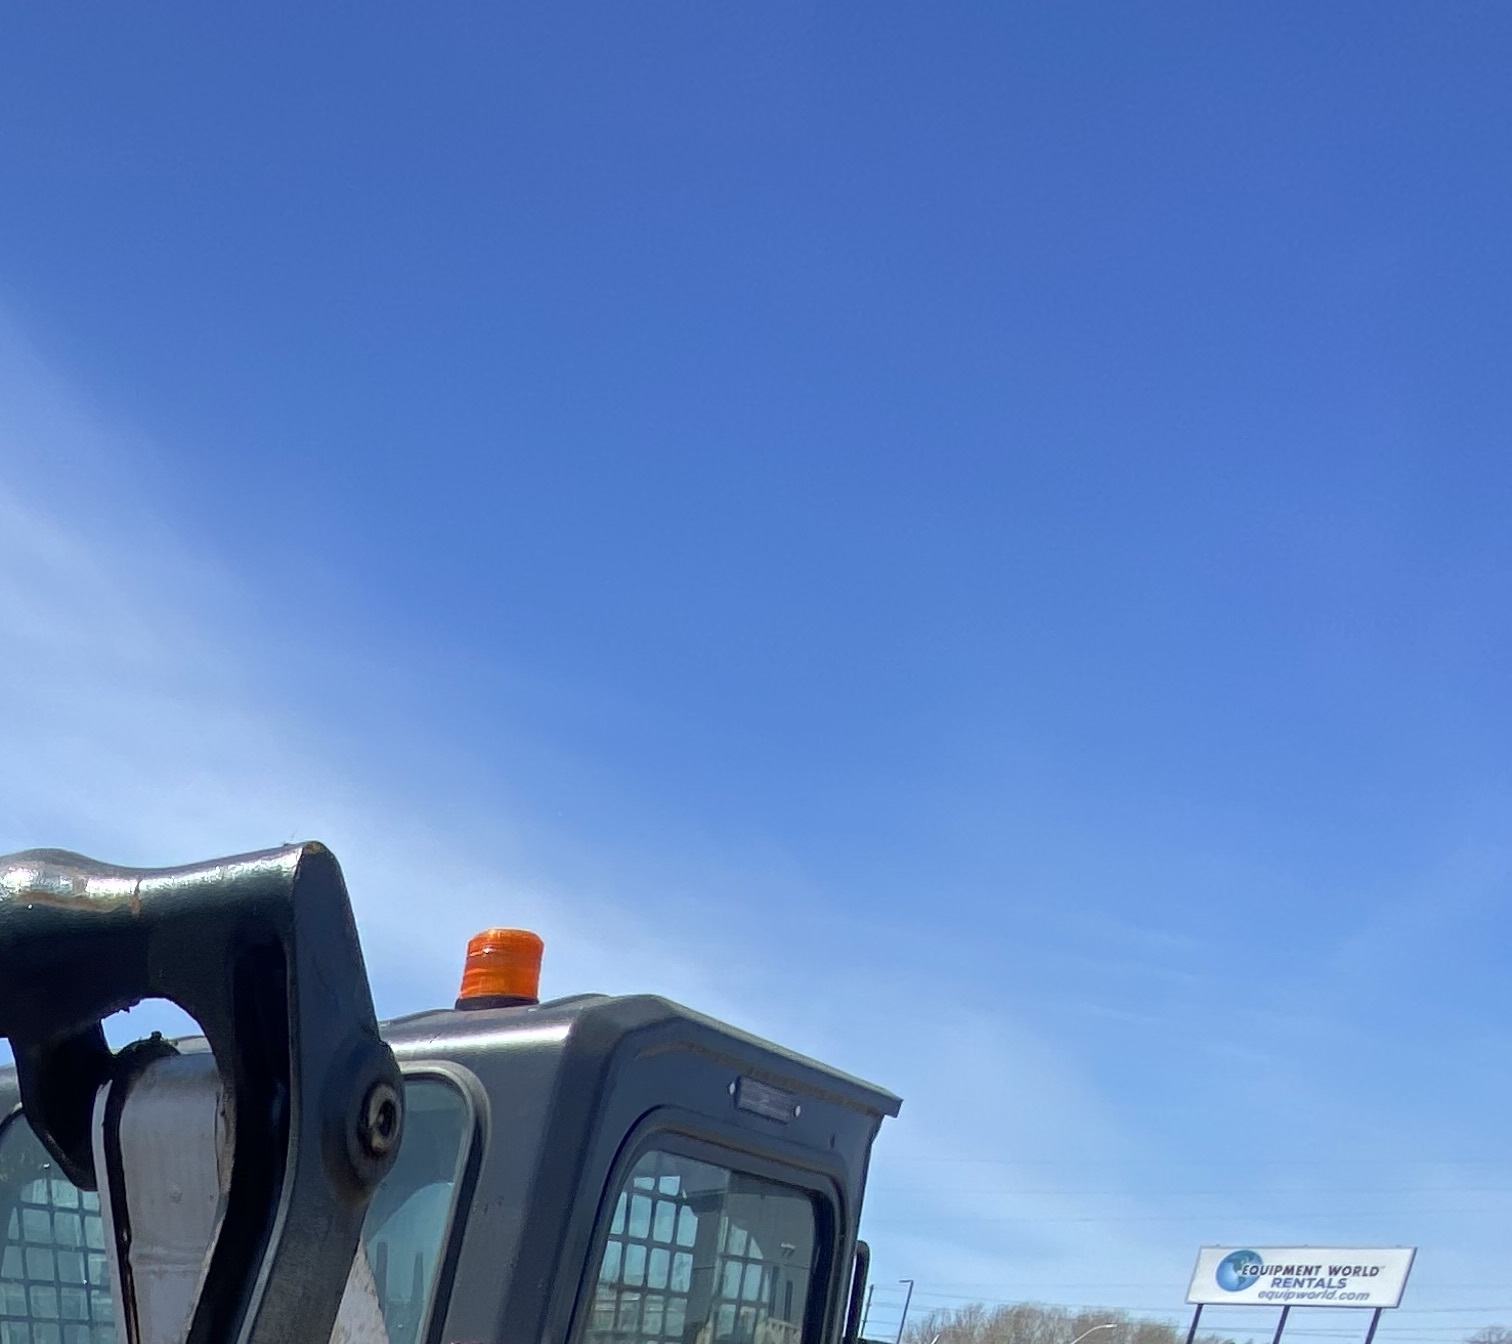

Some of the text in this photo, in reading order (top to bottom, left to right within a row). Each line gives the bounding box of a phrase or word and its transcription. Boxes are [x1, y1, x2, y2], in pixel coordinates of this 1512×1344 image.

[1241, 1265, 1380, 1277] EQUIPMENT WORLD
[1270, 1277, 1348, 1289] RENTALS
[1257, 1289, 1371, 1301] equipworld.com
